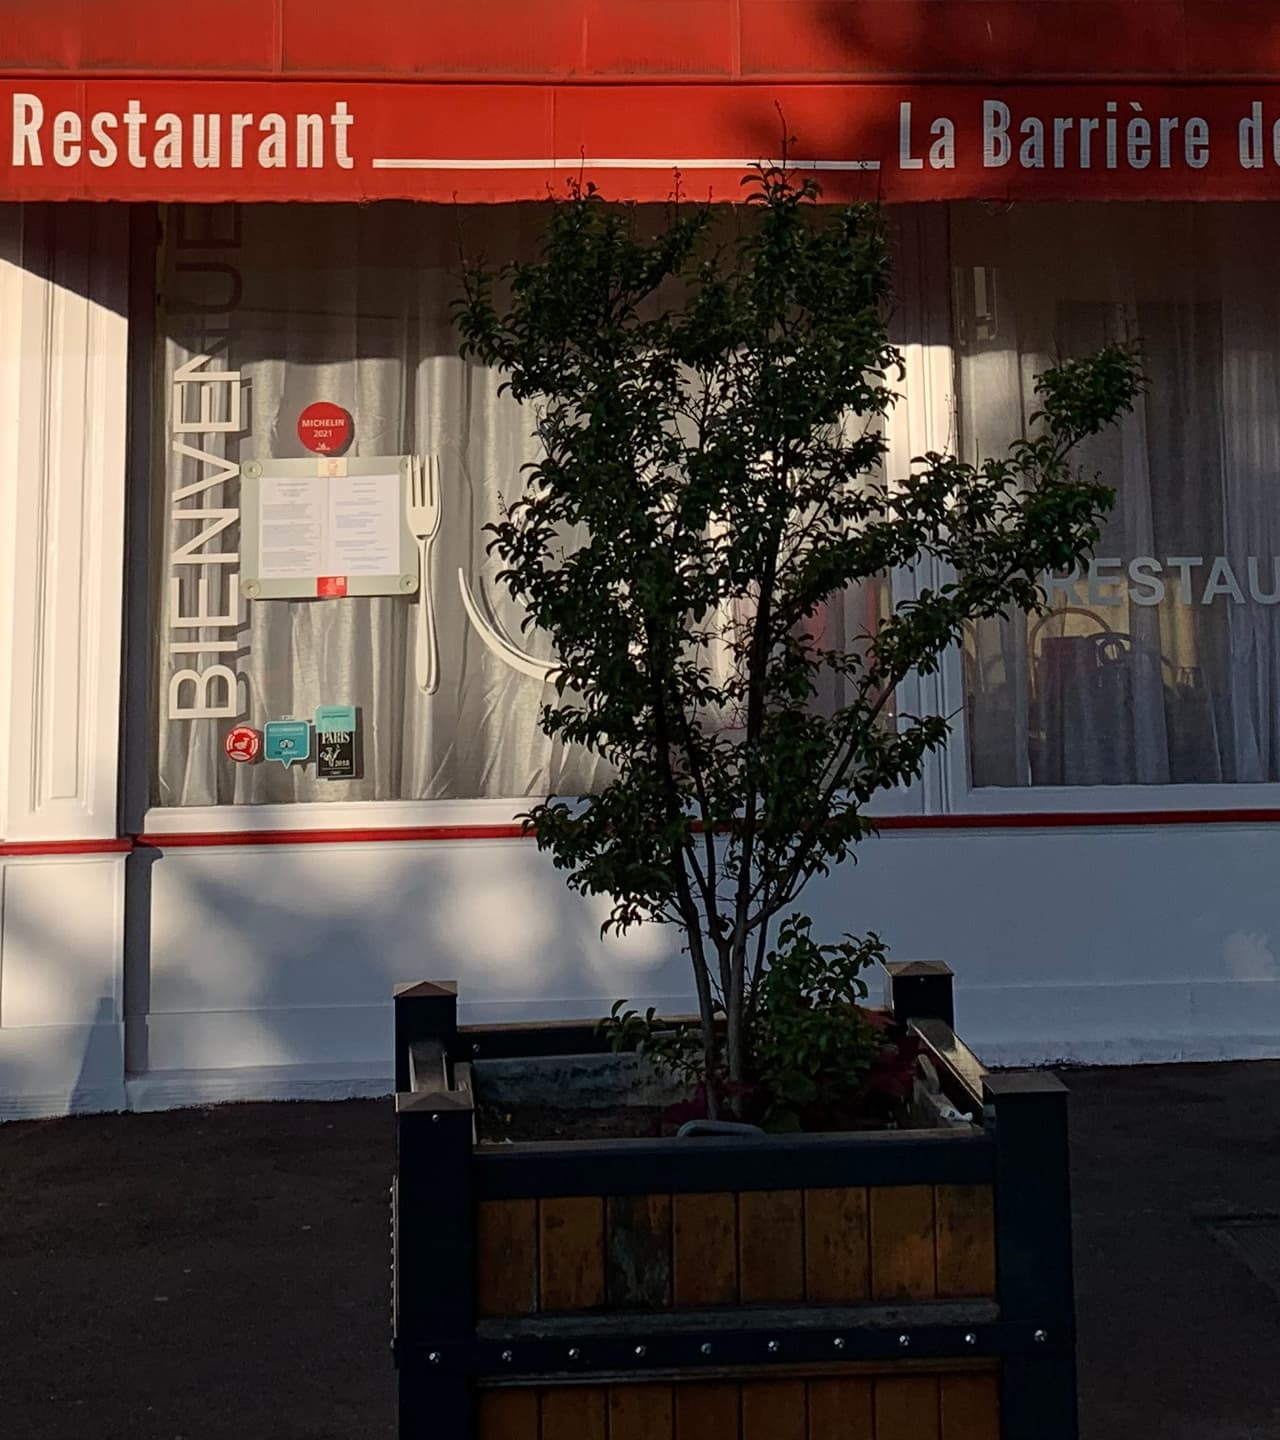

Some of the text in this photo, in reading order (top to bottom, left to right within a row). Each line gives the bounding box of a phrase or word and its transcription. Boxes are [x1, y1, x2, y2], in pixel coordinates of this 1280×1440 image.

[12, 93, 354, 168] Restaurant
[898, 101, 955, 169] La
[982, 99, 1209, 169] Barrière
[301, 418, 345, 428] MICHELIN
[313, 429, 333, 438] 2021
[321, 731, 351, 744] PARIS
